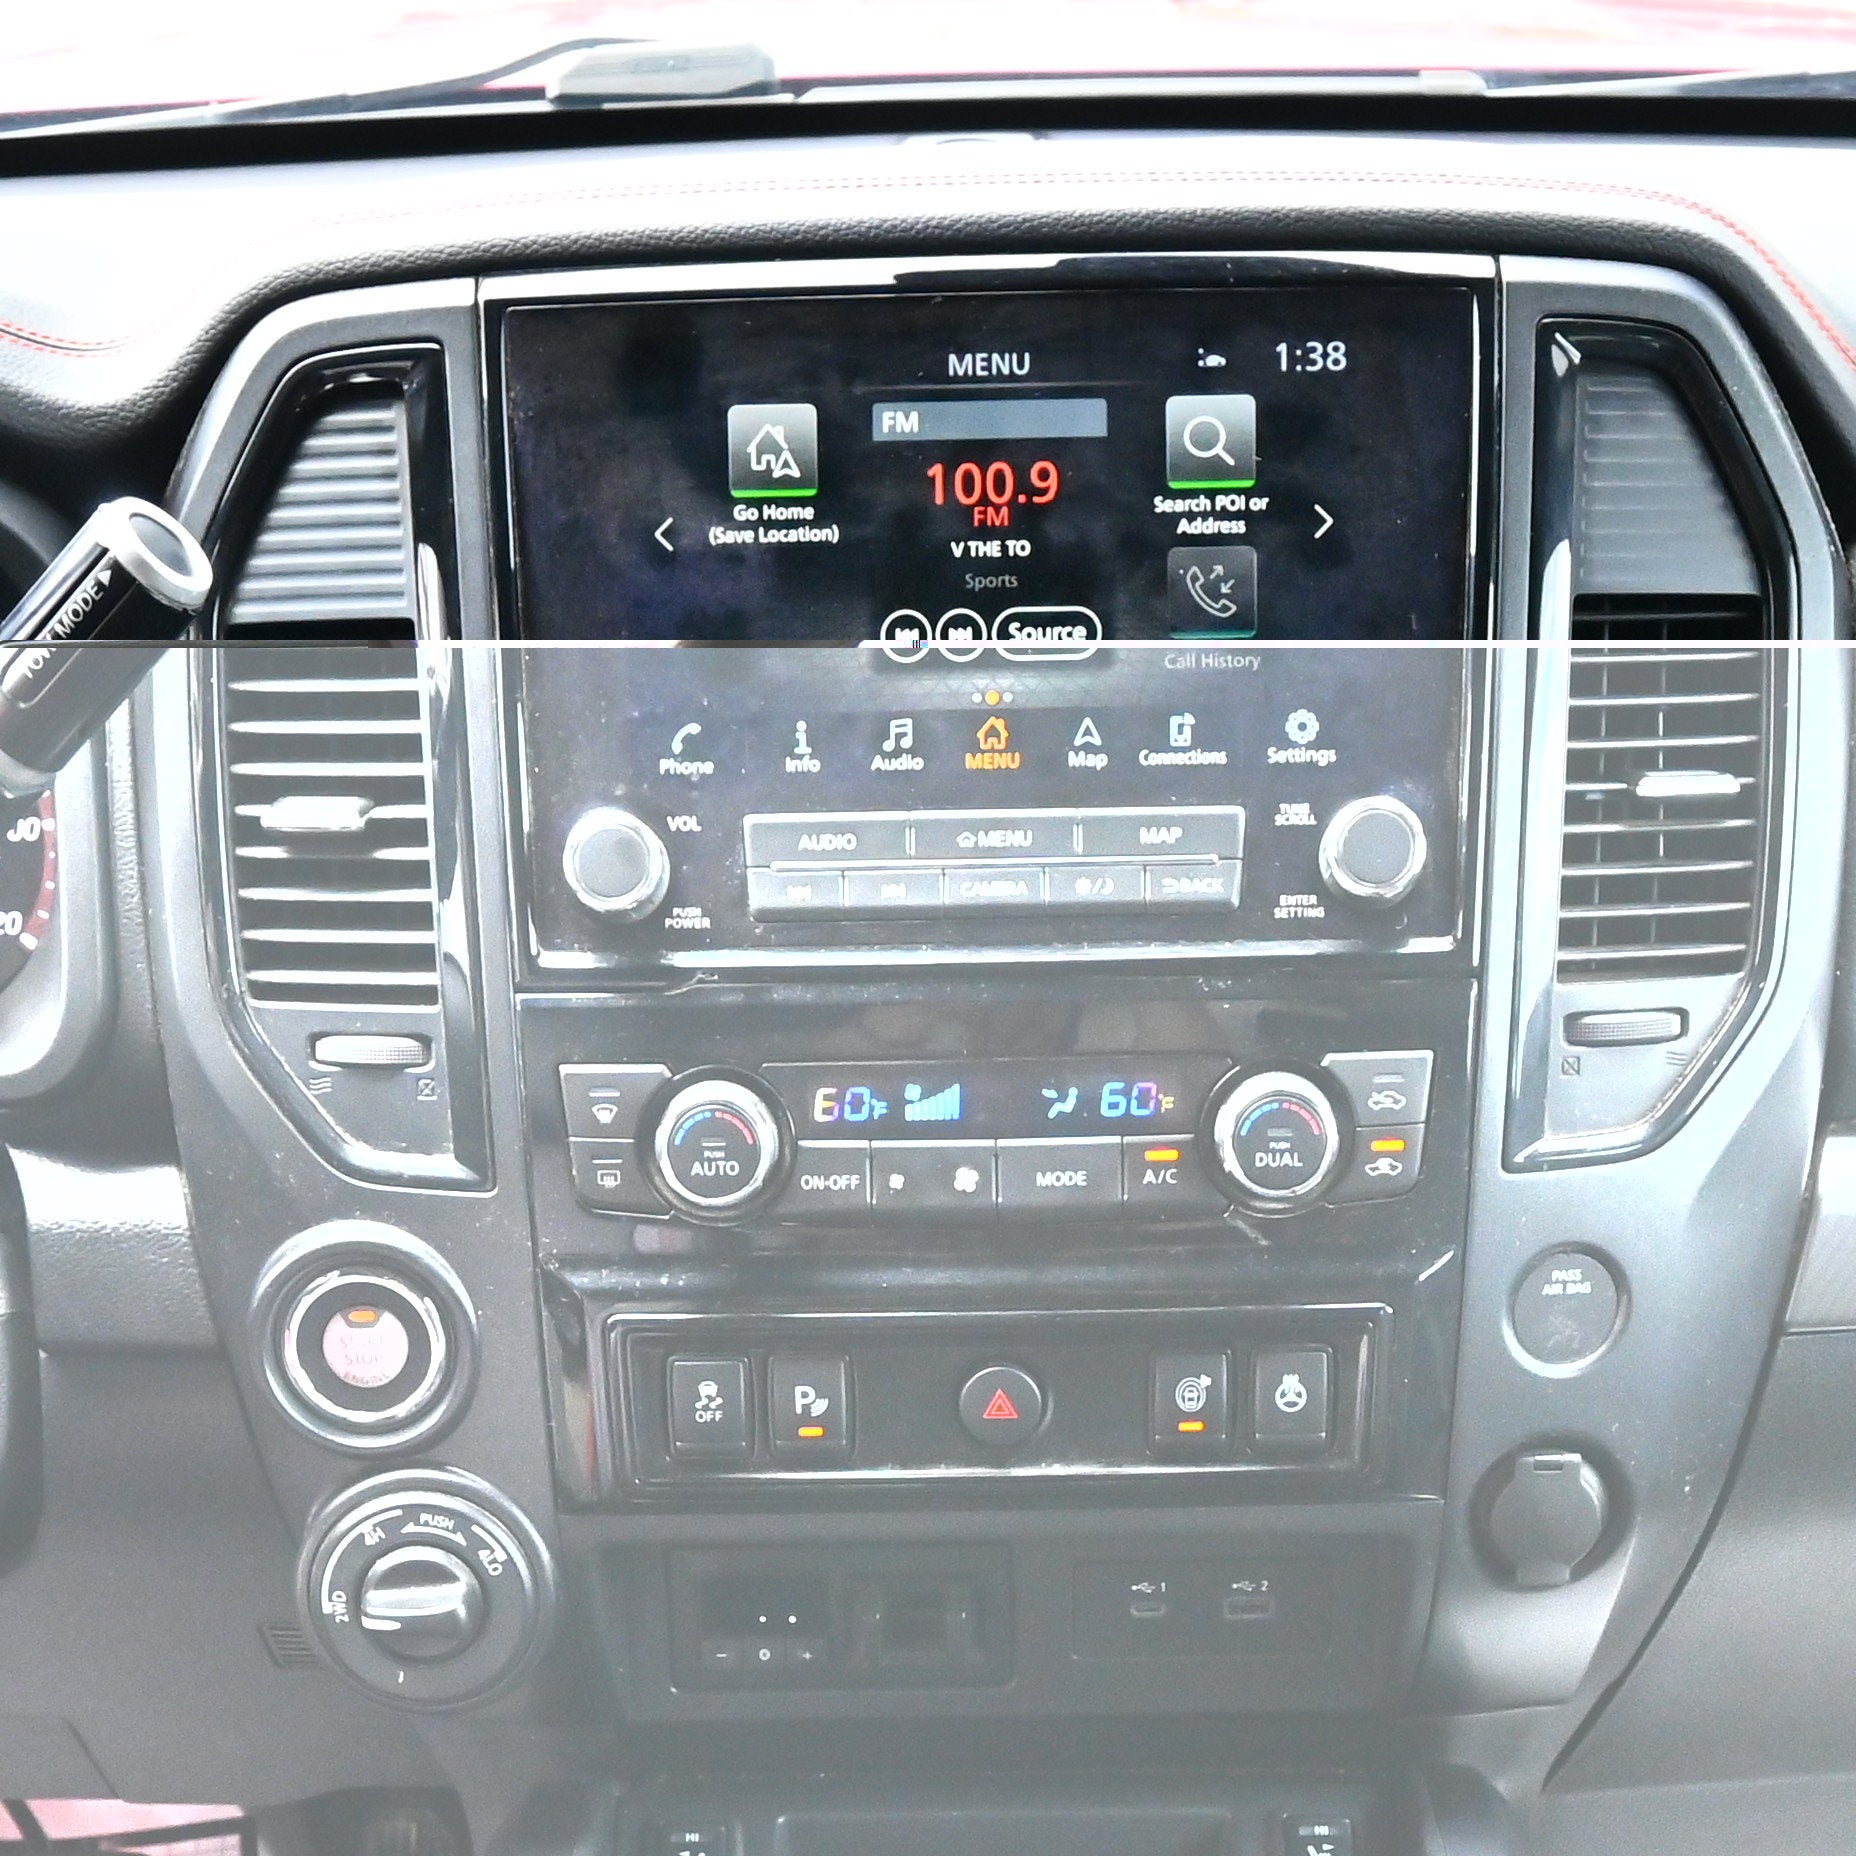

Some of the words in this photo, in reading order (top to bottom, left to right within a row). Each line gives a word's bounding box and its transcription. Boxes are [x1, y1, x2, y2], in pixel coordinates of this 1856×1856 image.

[947, 352, 1031, 378] MENU
[1275, 341, 1348, 373] 1:38
[881, 411, 920, 433] FM
[926, 460, 1061, 506] 100.9
[732, 504, 759, 521] Go
[762, 503, 815, 521] Home
[1153, 495, 1212, 513] Search
[1215, 494, 1246, 512] POI
[1249, 497, 1270, 511] or
[972, 506, 1010, 528] FM
[1177, 517, 1247, 535] Address
[708, 526, 755, 545] (Save
[758, 524, 840, 545] Location)
[950, 541, 966, 558] V
[968, 540, 1002, 558] THE
[1005, 539, 1032, 557] TO
[964, 573, 1018, 591] Sports
[53, 582, 105, 639] MODE
[1007, 621, 1088, 642] Source
[1164, 653, 1195, 670] Call
[1200, 653, 1262, 671] History
[659, 757, 715, 776] Phone
[785, 754, 821, 773] Info
[870, 753, 924, 772] Audio
[964, 752, 1022, 771] MENU
[1067, 751, 1109, 771] Map
[1139, 749, 1228, 767] Connections
[1266, 747, 1337, 767] Settings
[666, 815, 702, 832] VOL
[1274, 814, 1318, 826] SCROLL
[797, 833, 858, 852] AUDIO
[977, 830, 1034, 848] MENU
[1139, 826, 1184, 845] MAP
[958, 879, 1029, 898] CAMERA
[1279, 894, 1318, 907] ENTER
[672, 906, 702, 918] PUSH
[1273, 906, 1326, 919] SETTING
[664, 917, 711, 930] POWER
[690, 1160, 740, 1178] AUTO
[1255, 1151, 1304, 1168] DUAL
[1035, 1170, 1088, 1188] MODE
[1142, 1168, 1178, 1186] A/C
[1551, 1268, 1583, 1282] PASS
[695, 1410, 724, 1423] OFF
[419, 1512, 455, 1530] PUSH
[364, 1526, 386, 1546] 4H
[478, 1549, 503, 1577] 4LO
[331, 1590, 349, 1624] 2WD
[685, 1833, 700, 1843] HI
[1313, 1825, 1330, 1836] HI
